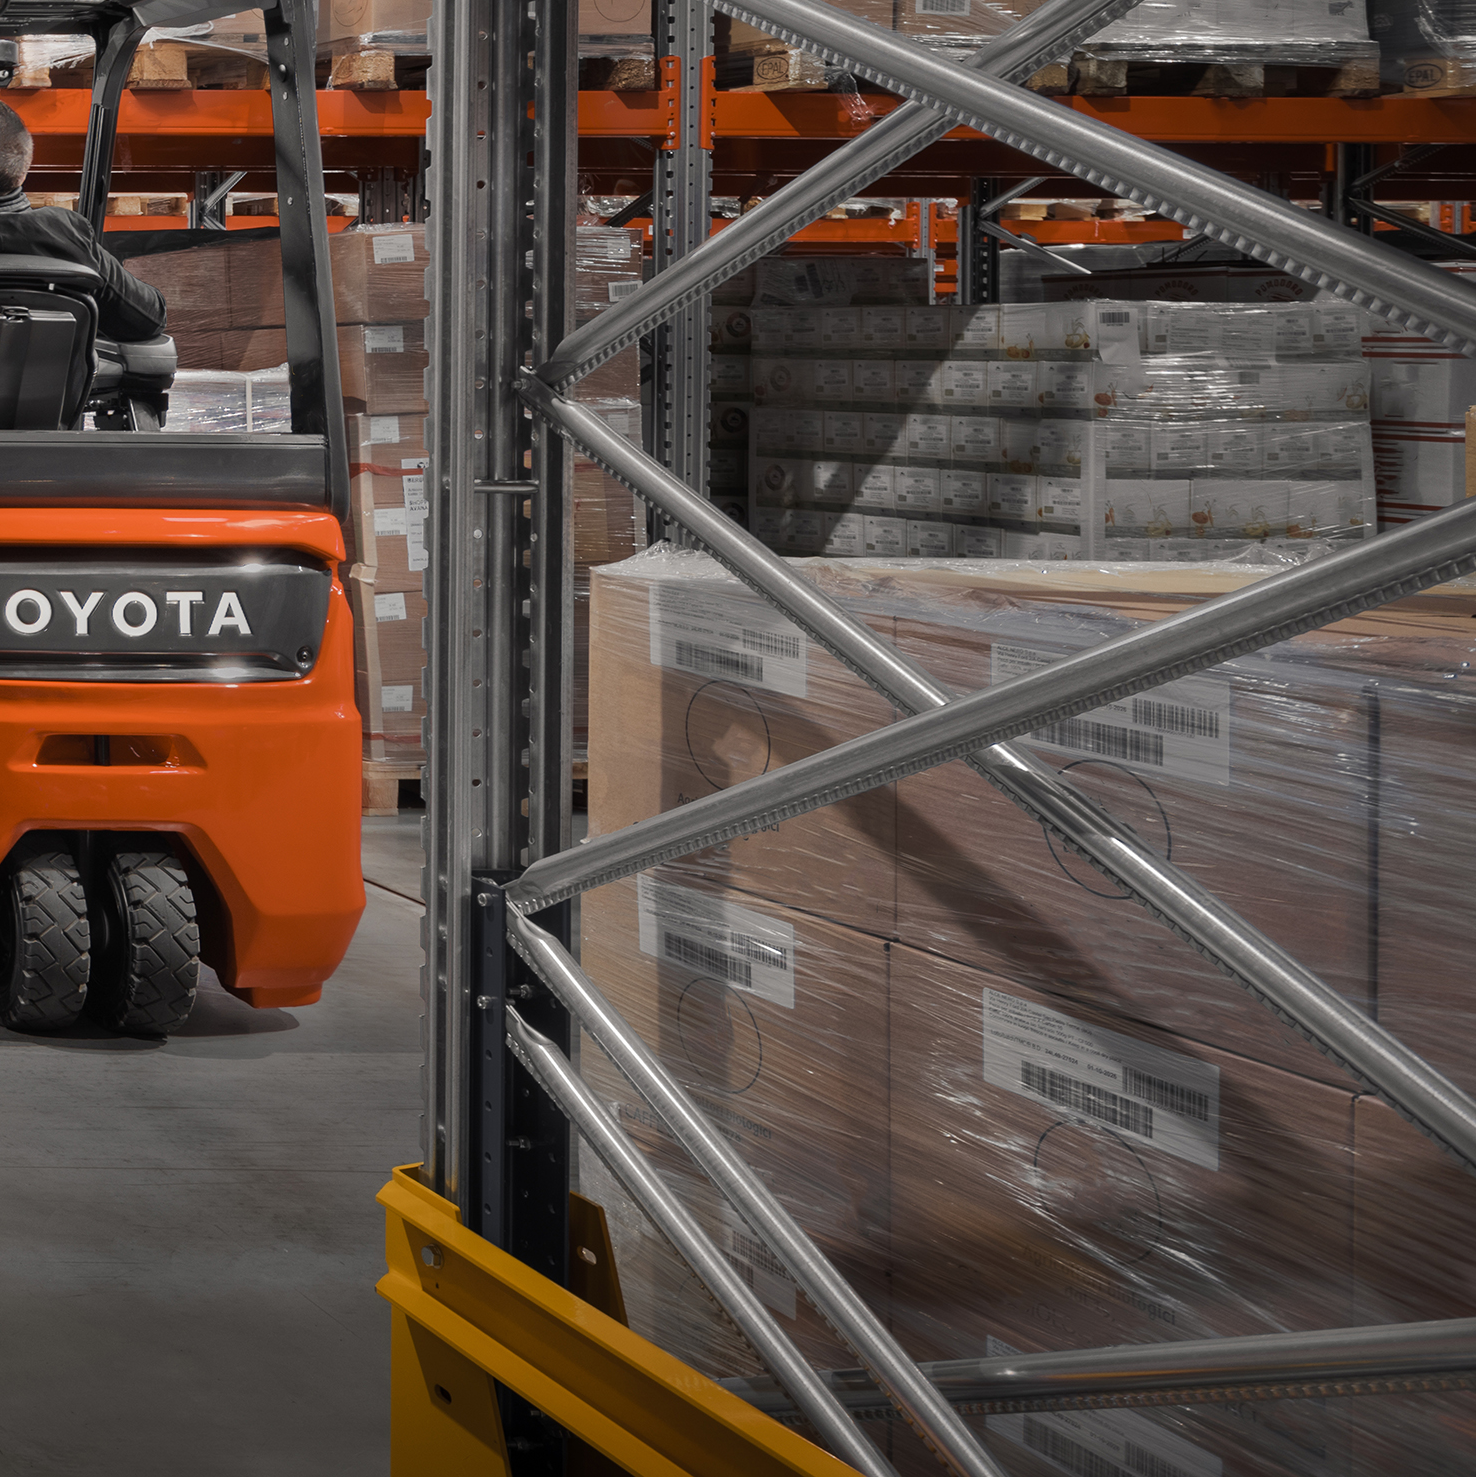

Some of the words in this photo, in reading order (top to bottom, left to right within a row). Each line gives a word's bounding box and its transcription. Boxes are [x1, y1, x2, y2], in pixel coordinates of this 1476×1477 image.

[761, 61, 784, 75] EPAL
[1408, 69, 1437, 84] EPAL
[1255, 278, 1304, 296] POMODORO
[725, 1105, 773, 1139] biologici
